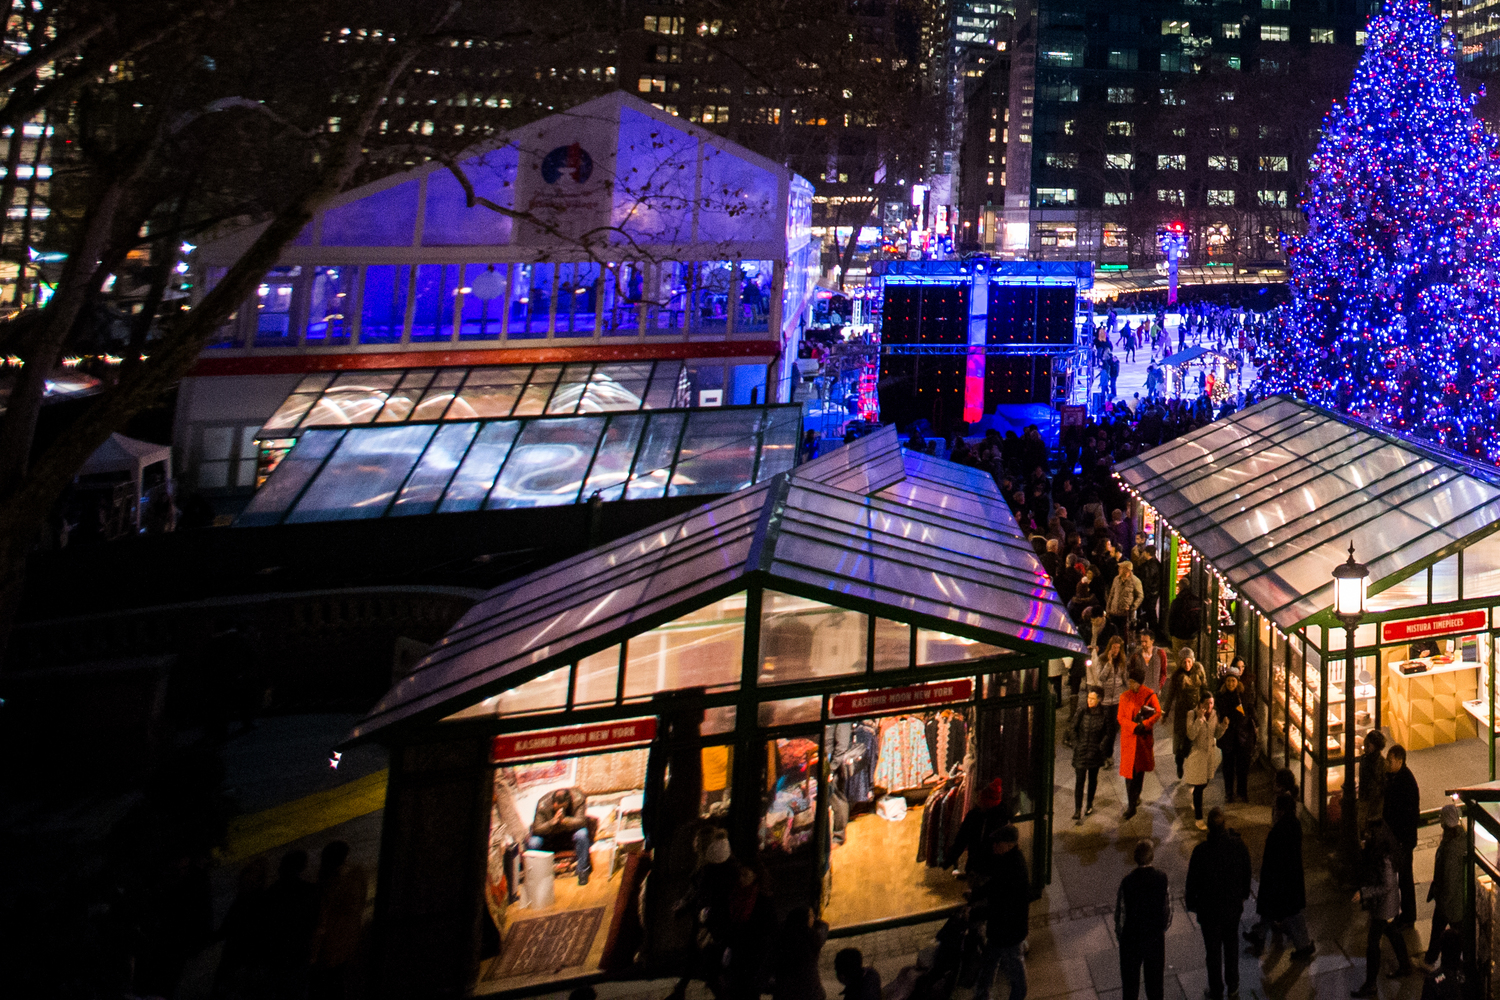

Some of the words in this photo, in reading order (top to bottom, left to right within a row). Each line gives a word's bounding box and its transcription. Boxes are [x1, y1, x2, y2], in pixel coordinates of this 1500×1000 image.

[1406, 622, 1431, 633] MISTURA
[1433, 618, 1464, 629] TIMEPIECES
[851, 695, 886, 708] KASHMIR
[889, 692, 912, 704] MOON
[913, 690, 931, 701] NEW
[933, 686, 954, 698] YORK
[514, 736, 558, 752] KASHMIR
[558, 733, 587, 746] MOON
[588, 730, 610, 742] NEW
[611, 726, 636, 739] YORK
